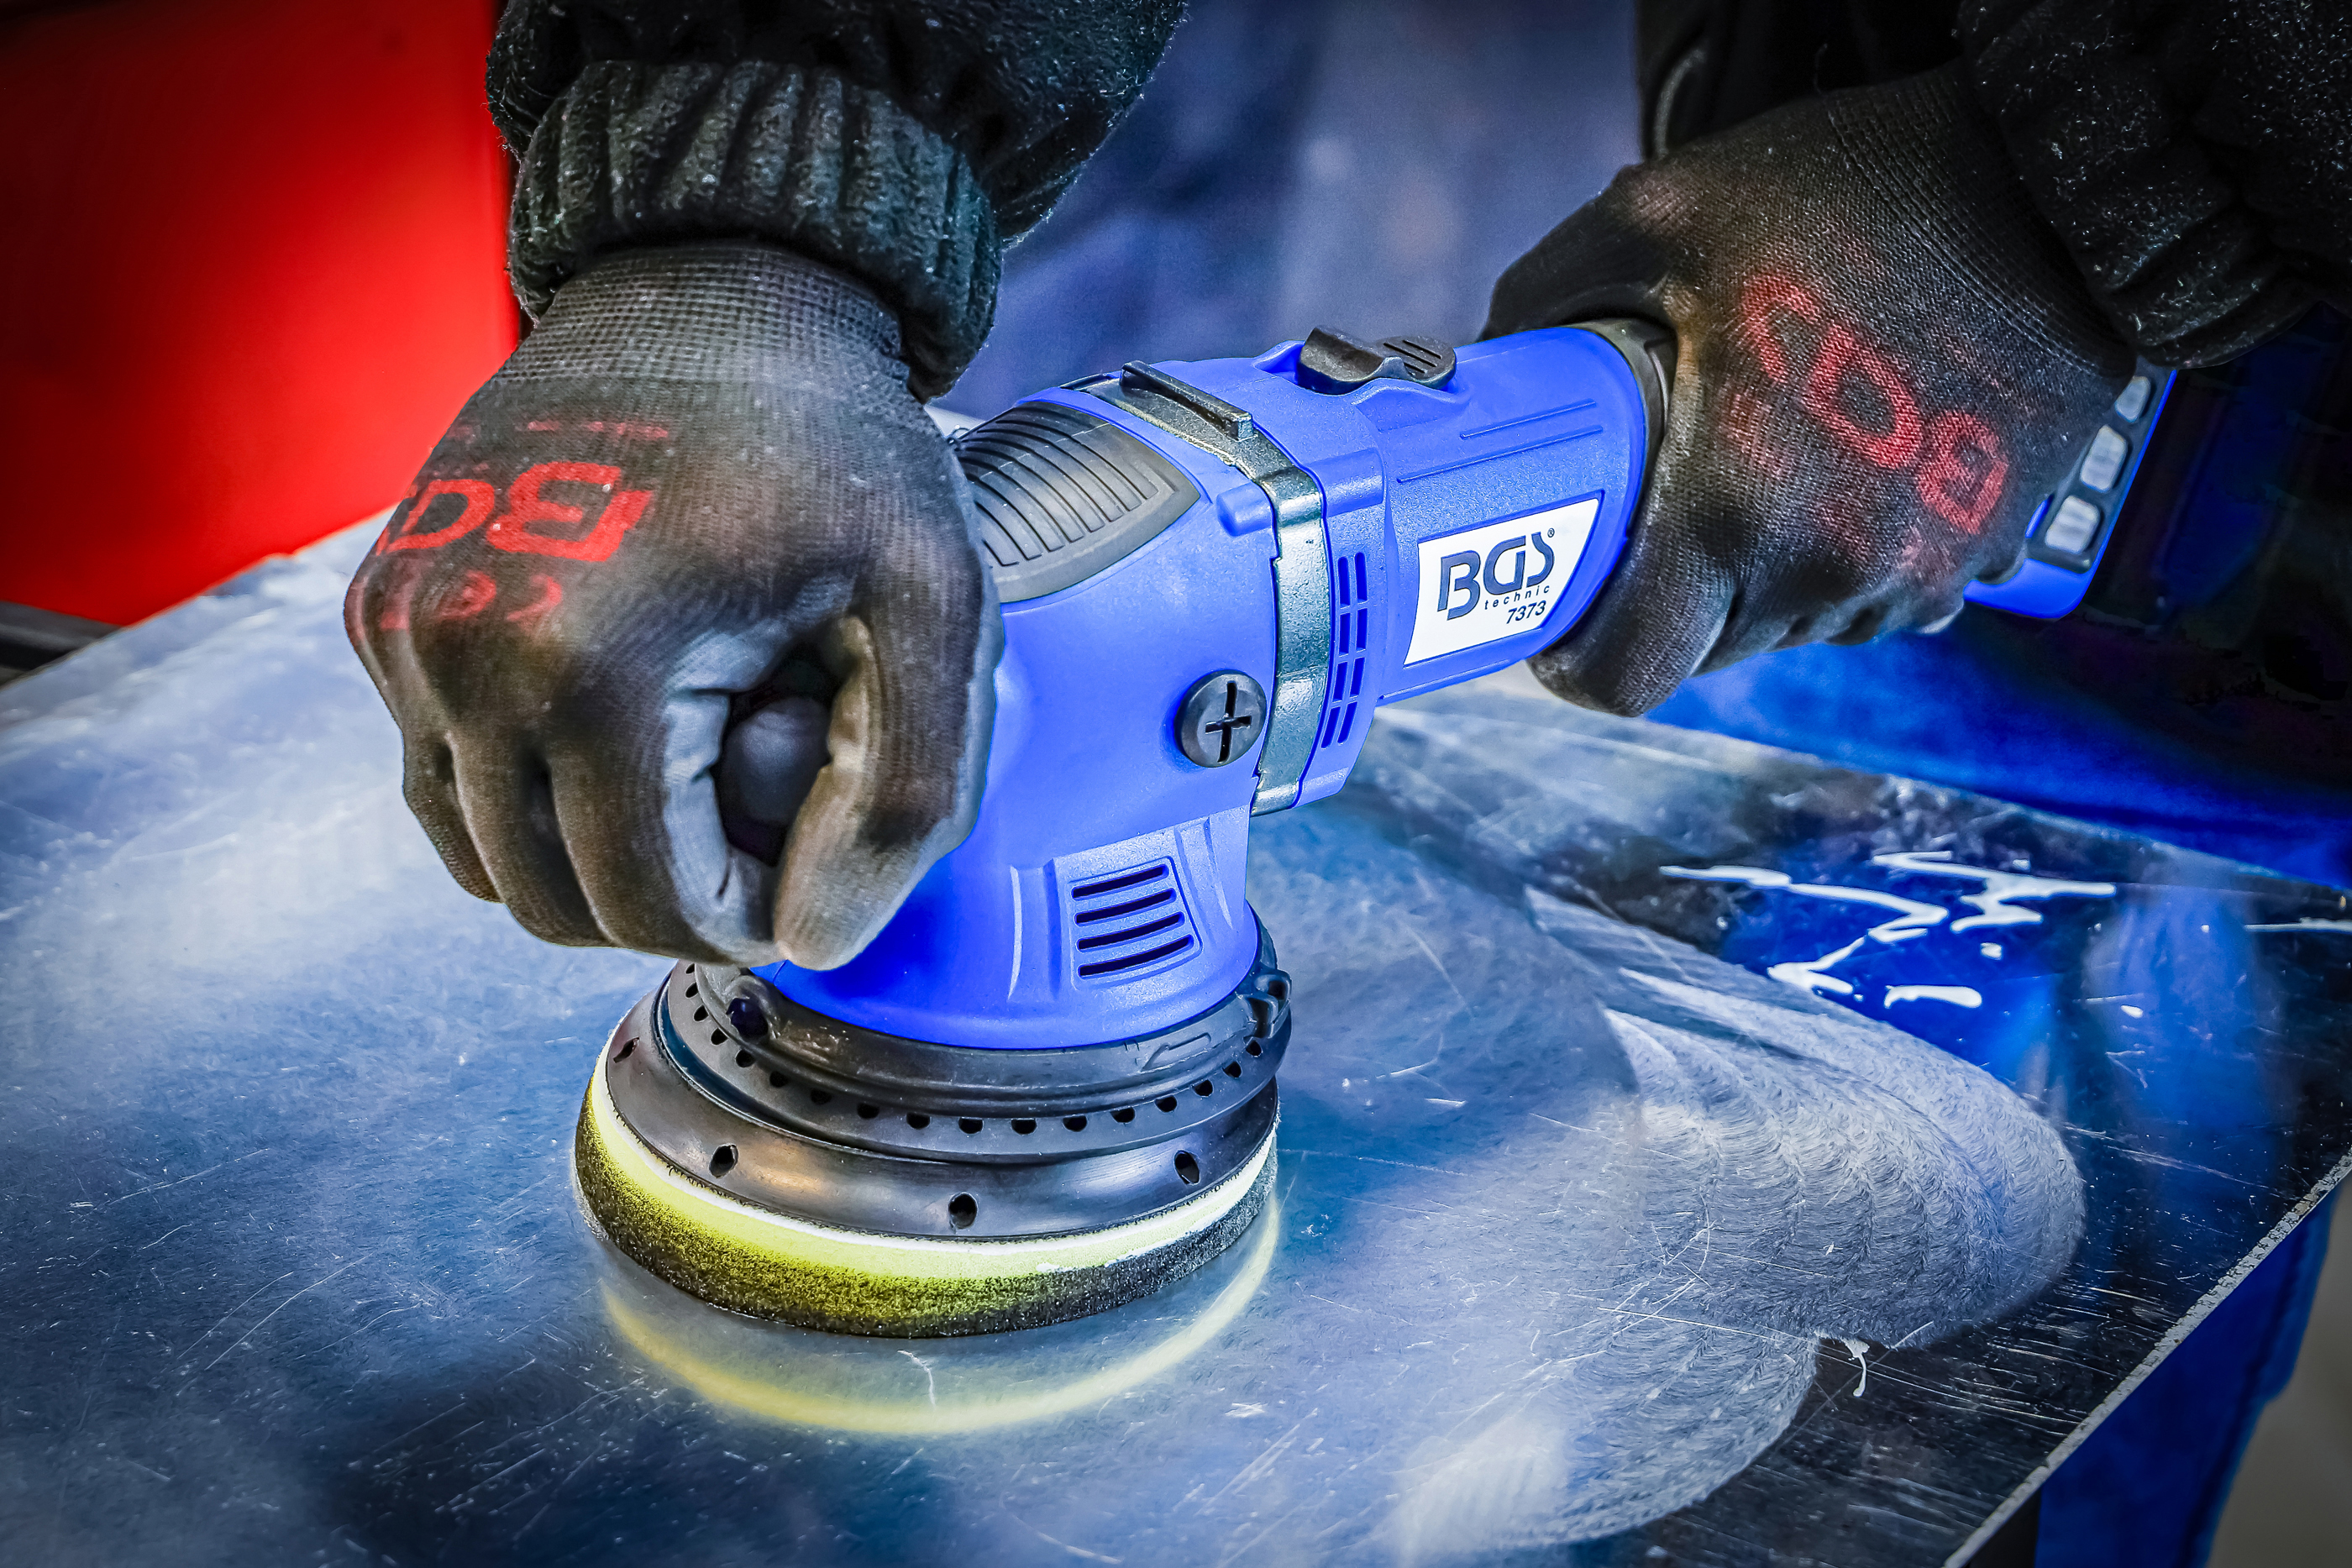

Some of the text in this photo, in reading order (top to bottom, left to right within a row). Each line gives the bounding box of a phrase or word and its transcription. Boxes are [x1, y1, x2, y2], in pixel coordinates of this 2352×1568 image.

[375, 460, 654, 562] BG
[1484, 585, 1550, 610] technic
[1505, 600, 1547, 624] 7373
